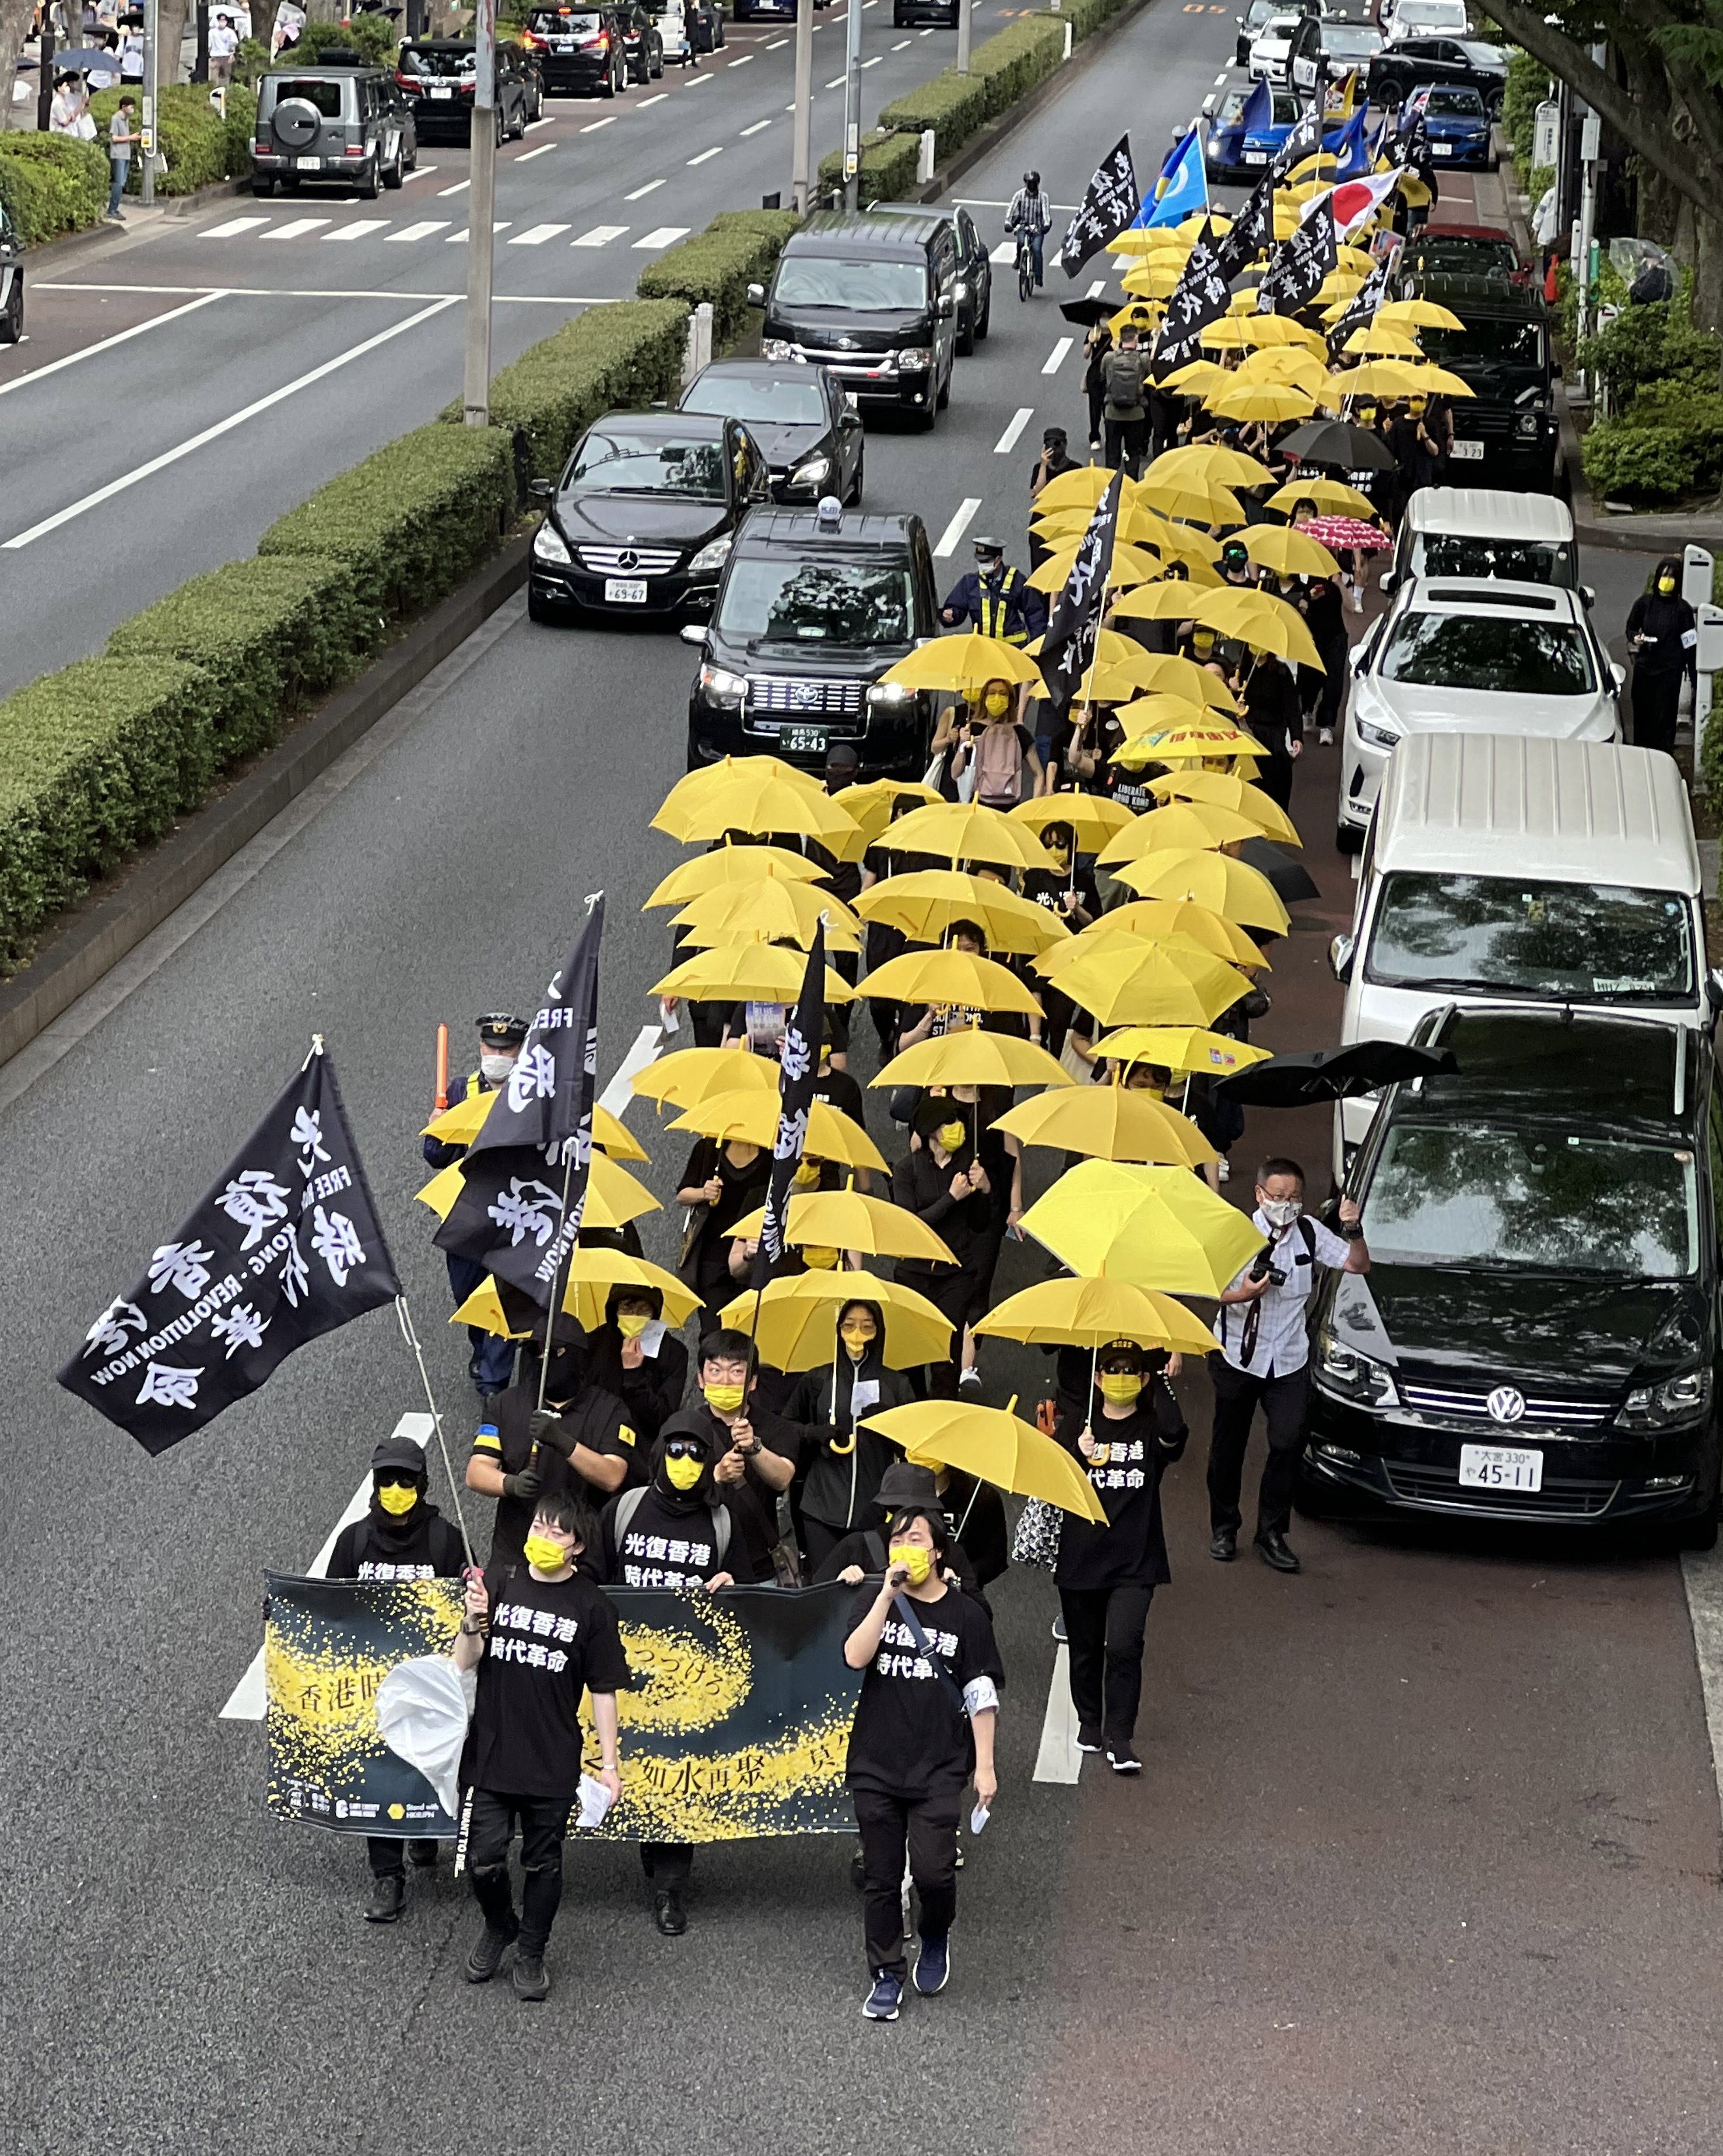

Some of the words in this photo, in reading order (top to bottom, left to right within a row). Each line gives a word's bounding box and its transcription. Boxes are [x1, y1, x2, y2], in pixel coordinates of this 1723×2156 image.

[790, 736, 826, 752] 65-43
[1481, 1451, 1504, 1462] 大宮
[1505, 1452, 1525, 1465] 330
[1478, 1464, 1533, 1487] 45-11
[624, 1532, 711, 1567] 光復香港
[492, 1602, 578, 1643] 光復香港
[490, 1636, 569, 1674] 時代革命
[876, 1652, 954, 1680] 時代革
[642, 1753, 766, 1796] 如水再聚
